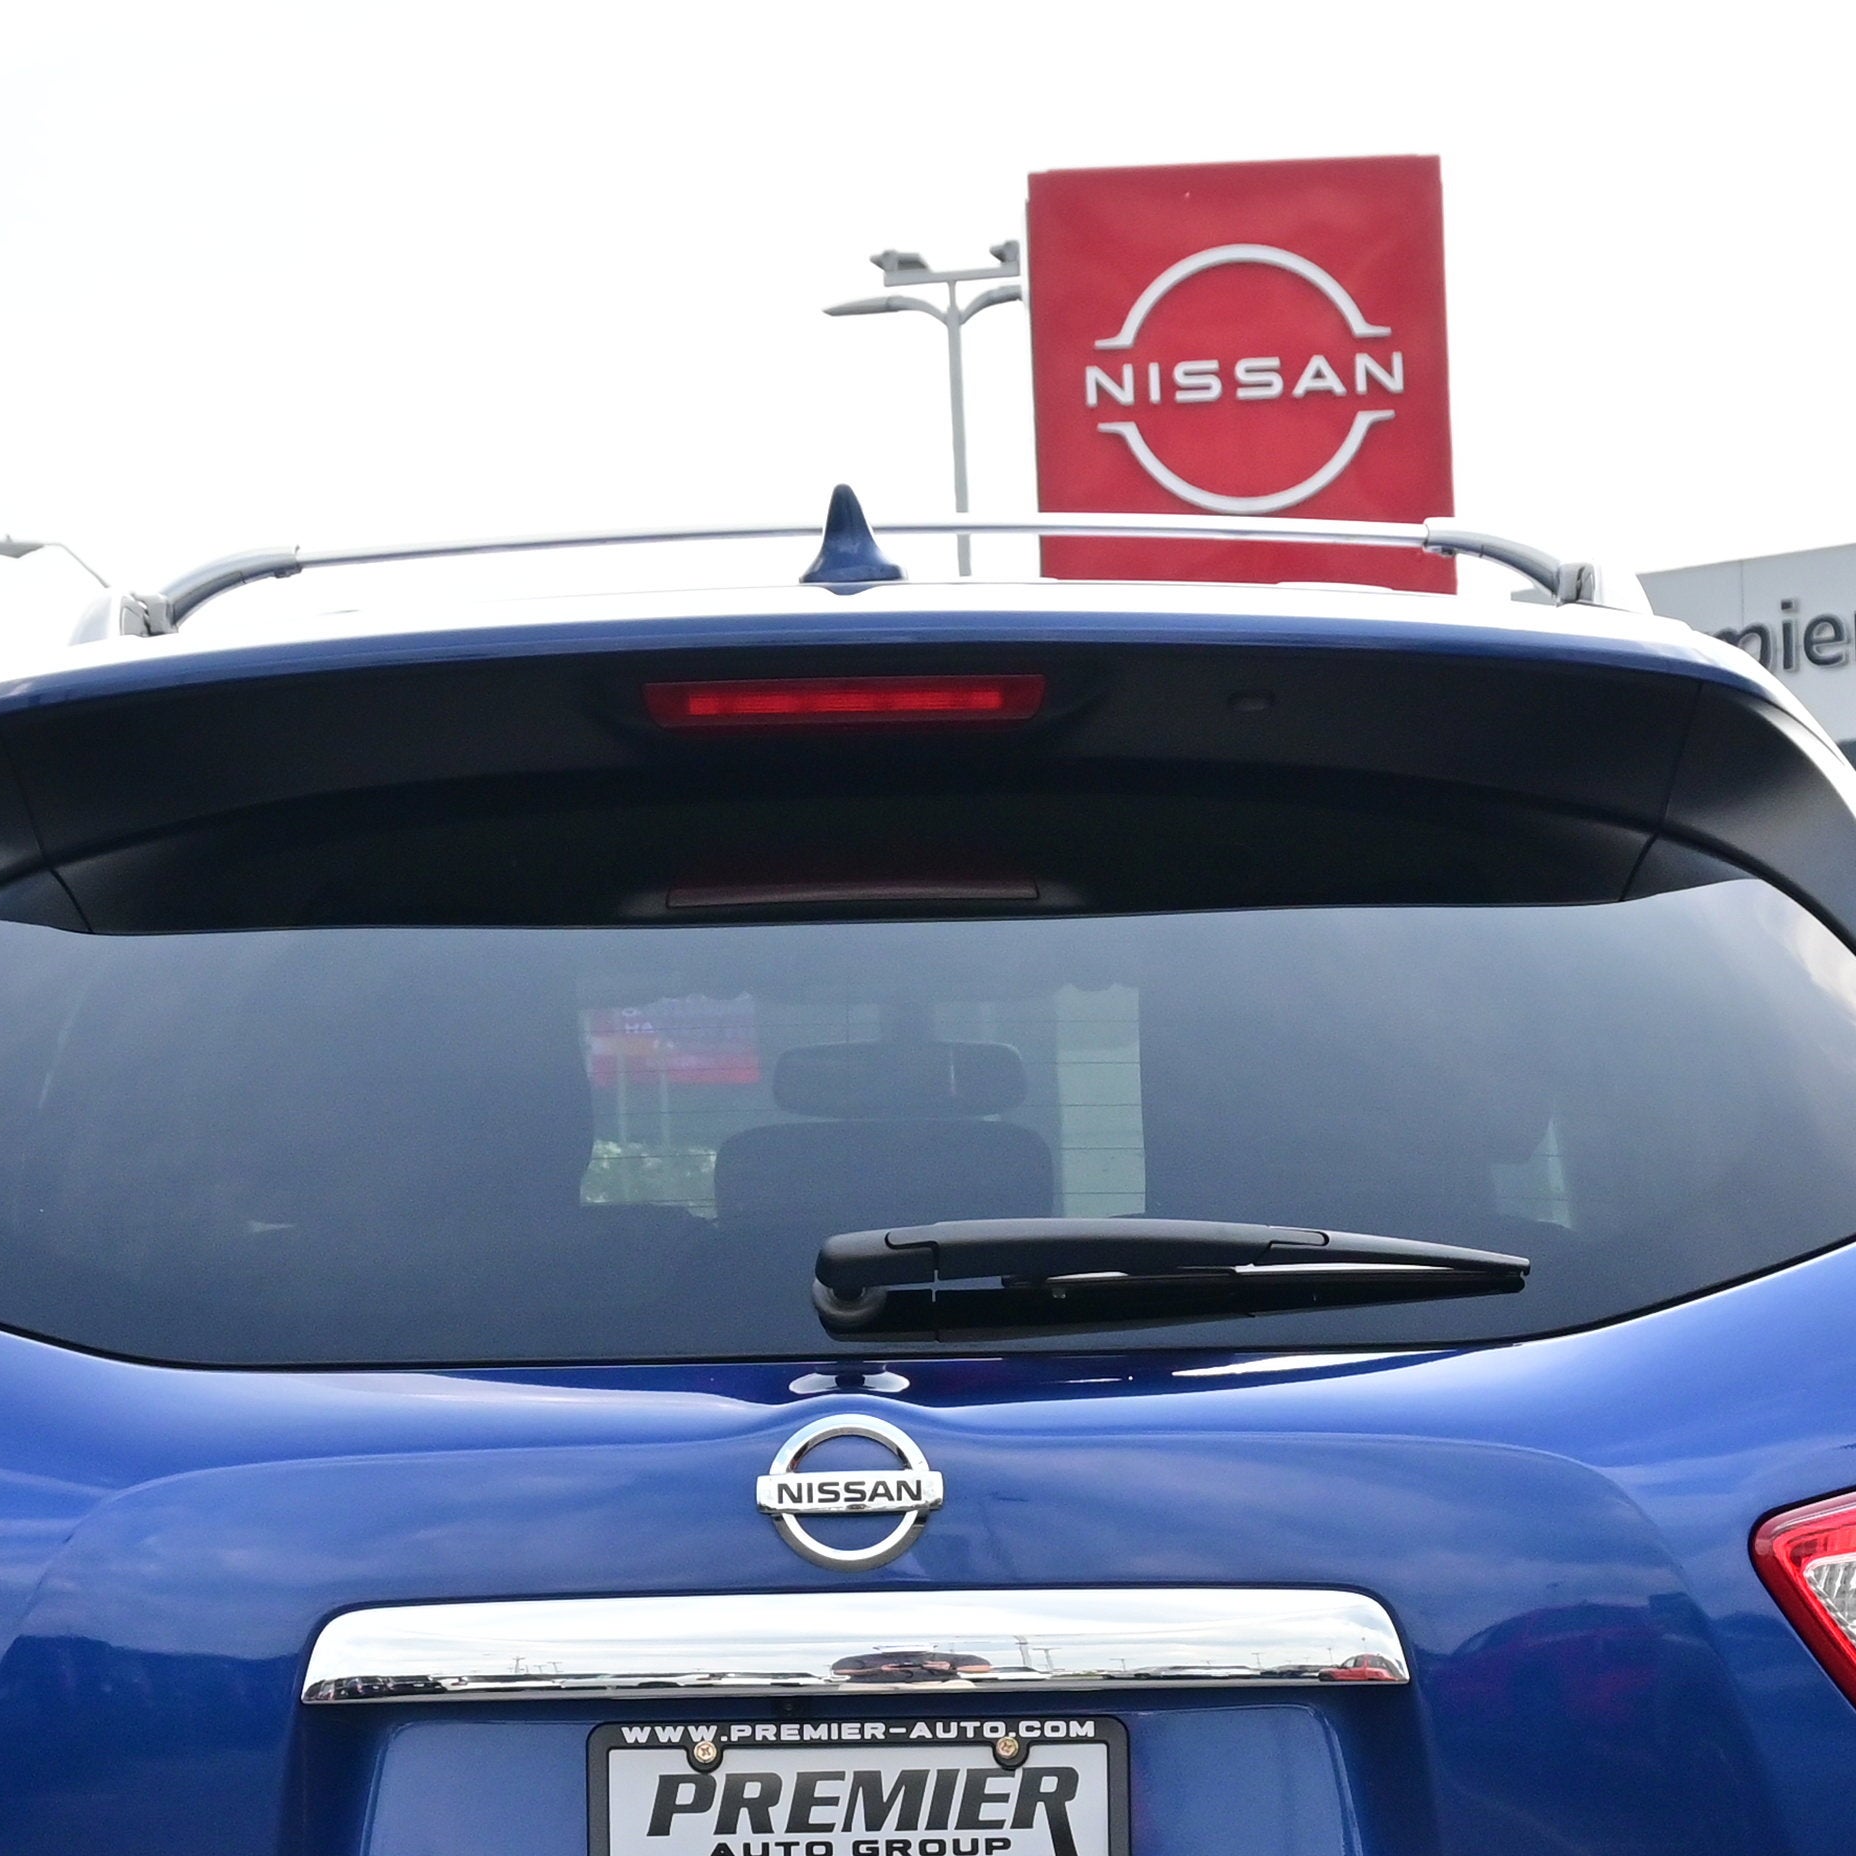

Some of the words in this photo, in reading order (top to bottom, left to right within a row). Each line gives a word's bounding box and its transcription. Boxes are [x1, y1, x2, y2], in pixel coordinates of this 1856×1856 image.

[1085, 351, 1405, 408] NISSAN
[777, 1479, 922, 1505] NISSAN
[621, 1719, 1096, 1744] WWW.PREMIER-AUTO.COM
